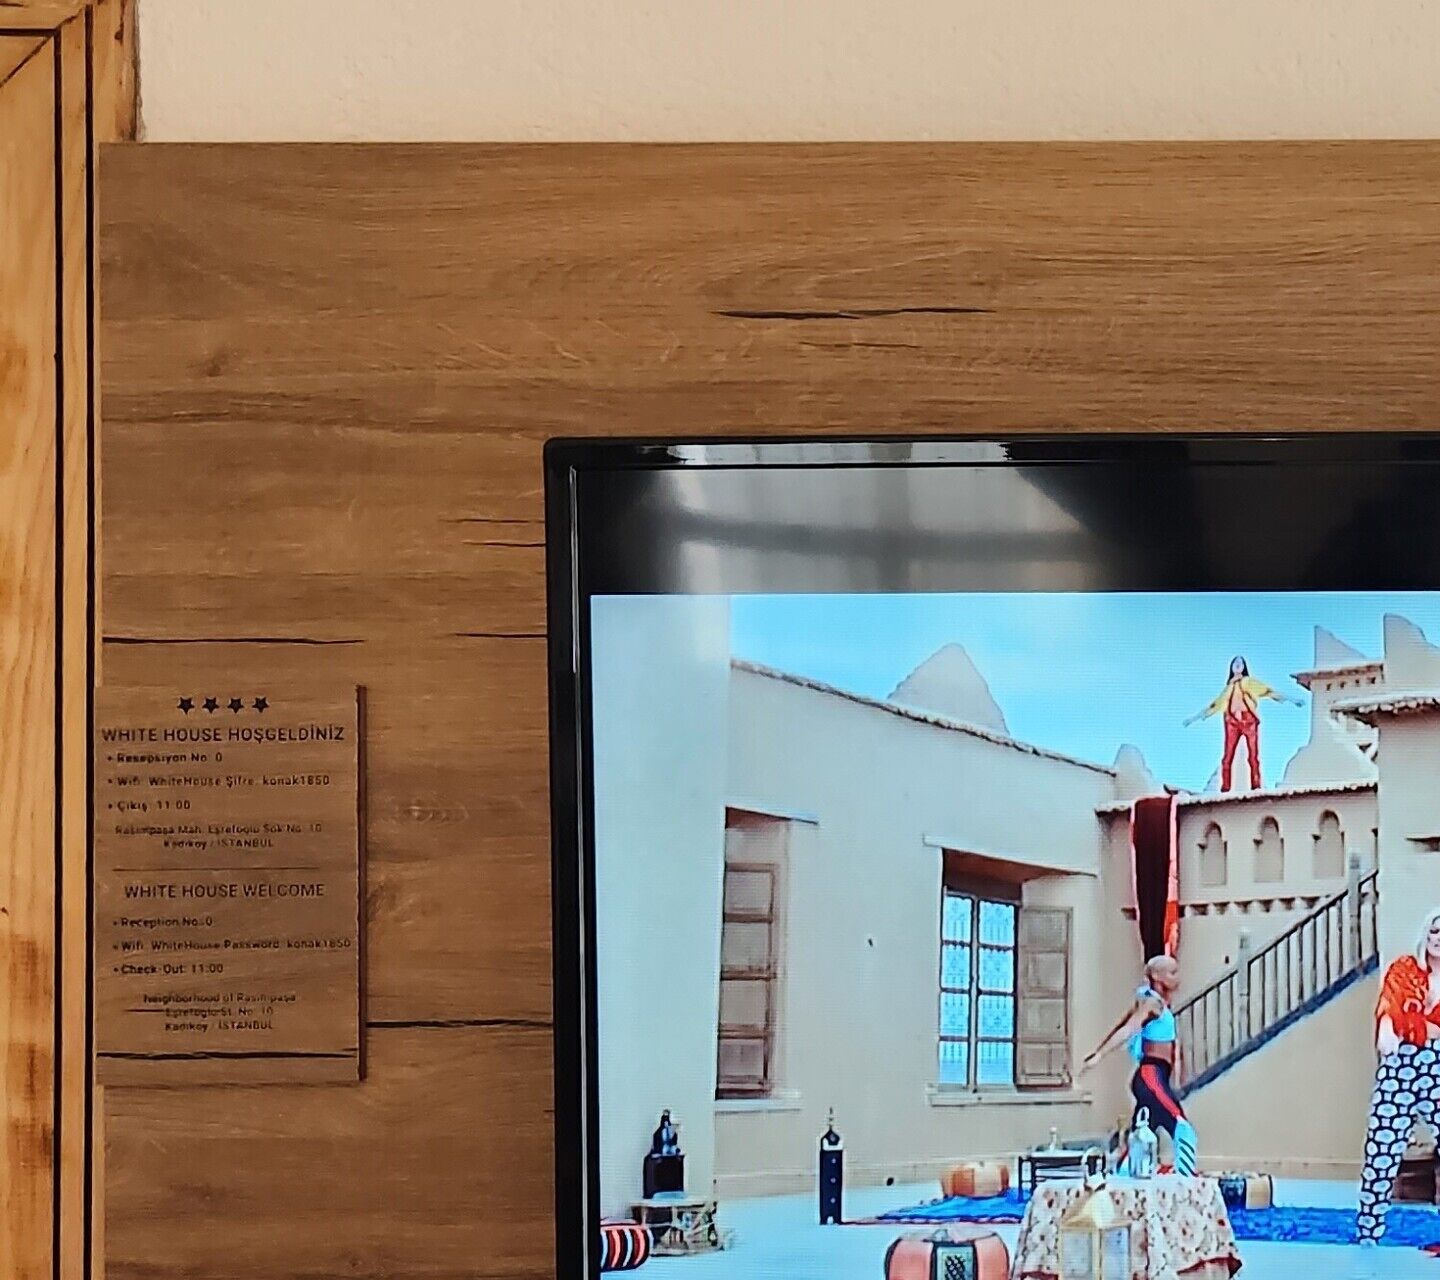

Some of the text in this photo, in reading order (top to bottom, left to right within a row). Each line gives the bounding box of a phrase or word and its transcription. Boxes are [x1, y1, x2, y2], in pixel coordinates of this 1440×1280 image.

[101, 724, 345, 744] WHITE HOUSE HOŞGELDİNİZ
[125, 884, 325, 899] WHITE HOUSE WELCOME
